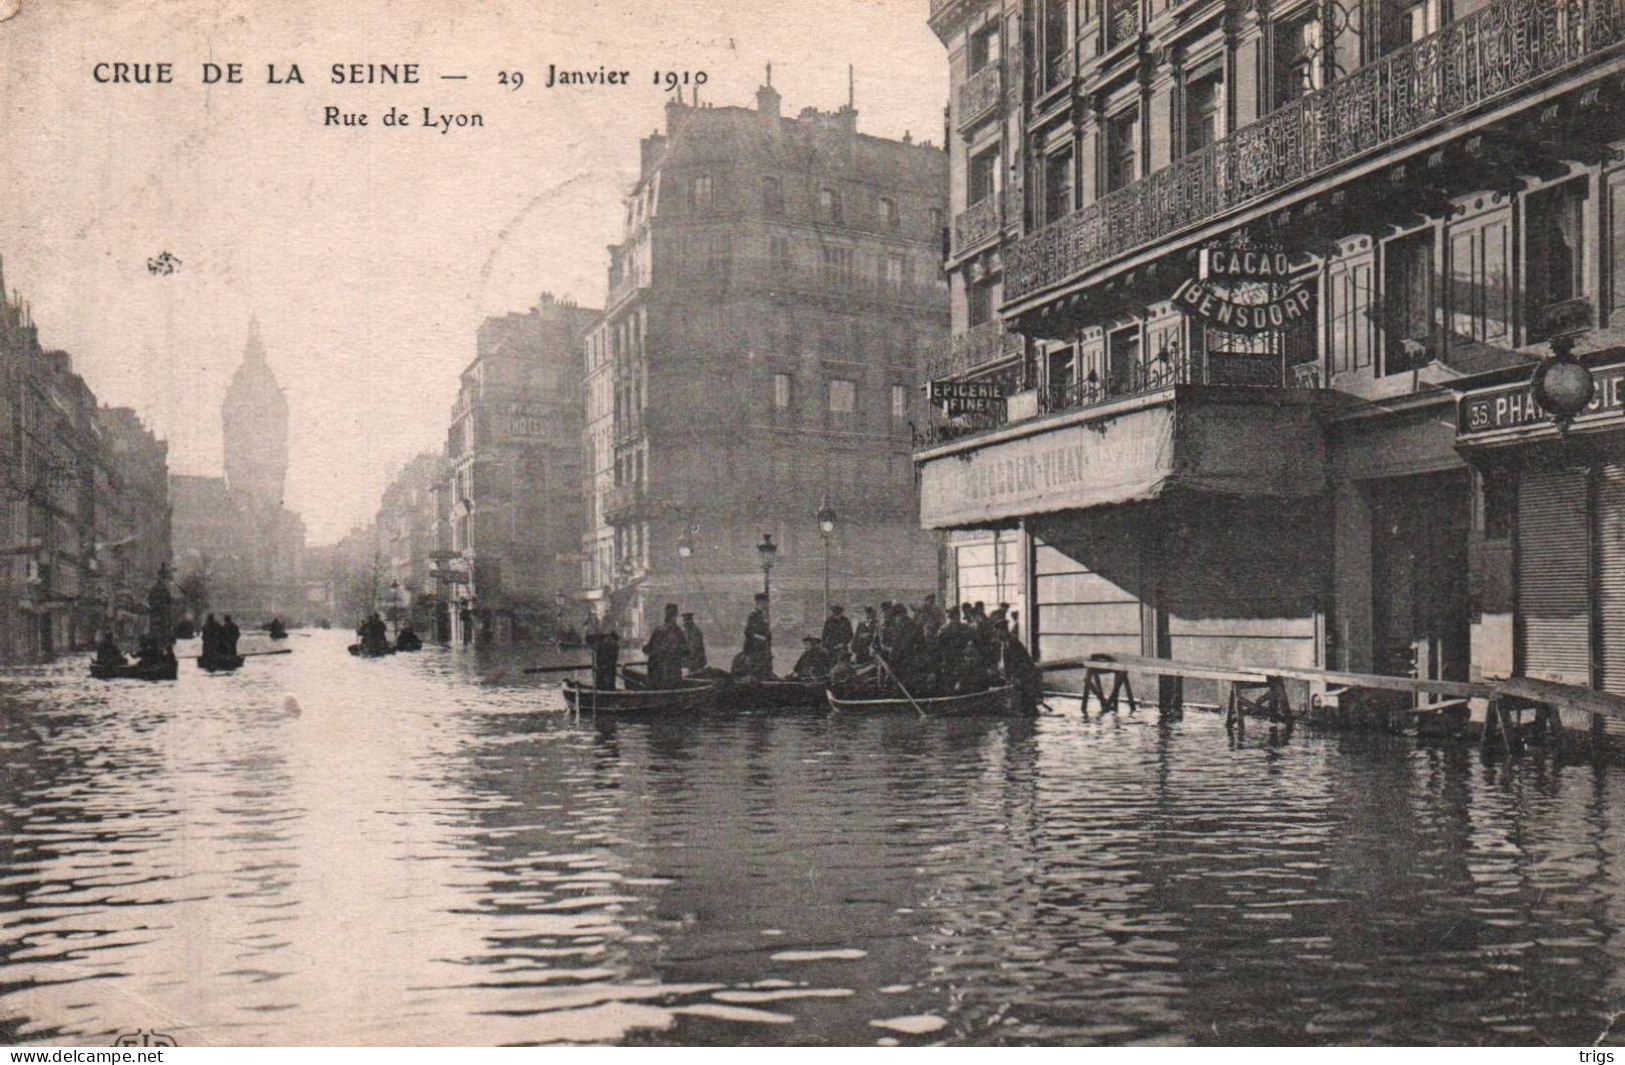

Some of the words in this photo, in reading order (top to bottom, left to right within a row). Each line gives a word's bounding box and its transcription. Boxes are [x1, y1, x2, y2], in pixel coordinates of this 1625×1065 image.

[1212, 250, 1288, 275] CACAO
[1184, 283, 1311, 330] BENSDORP
[933, 384, 1002, 398] EPICERIE
[1495, 375, 1625, 426] PHACIE
[950, 399, 985, 412] FINE
